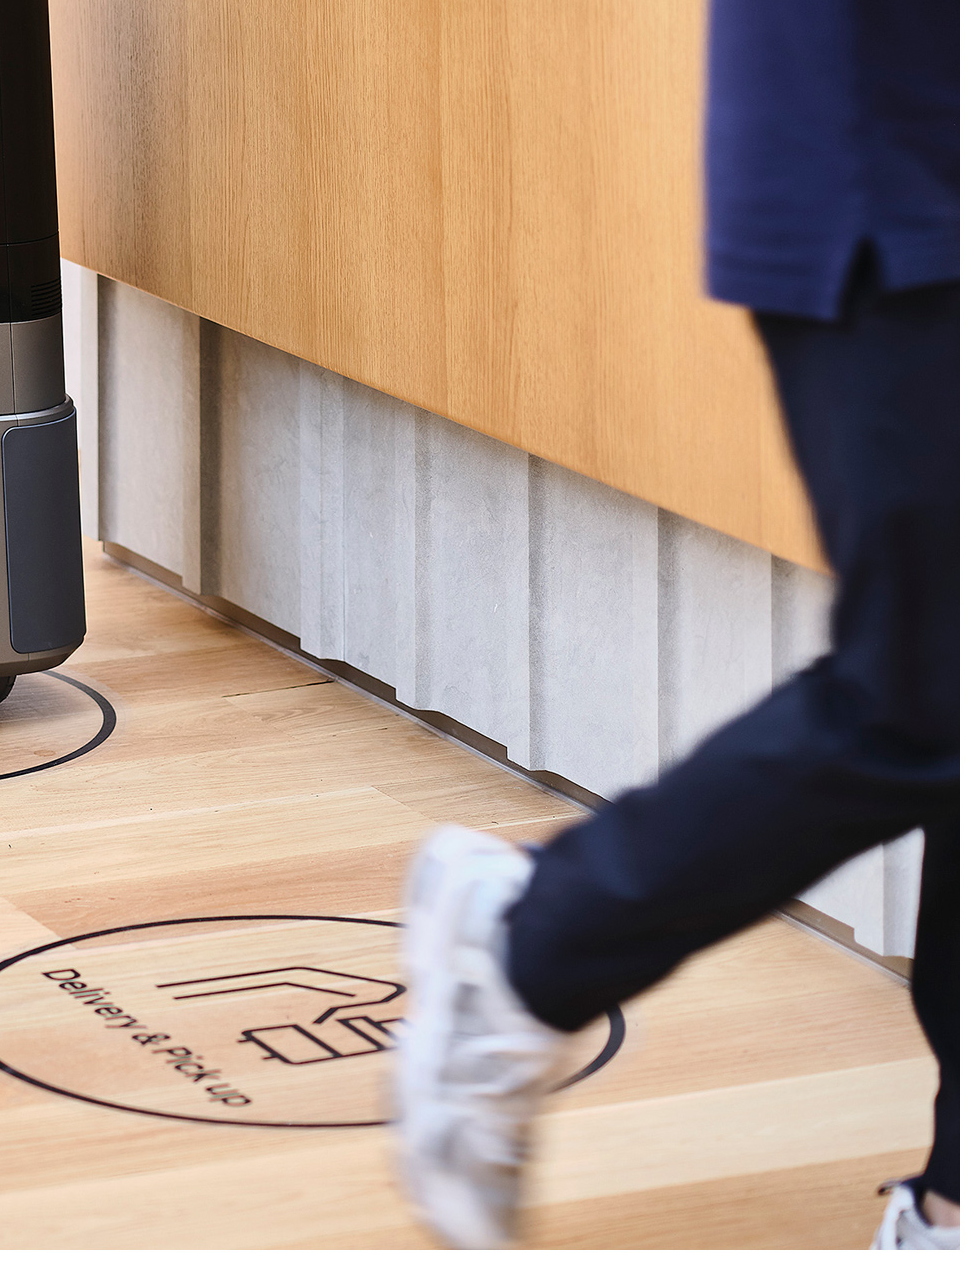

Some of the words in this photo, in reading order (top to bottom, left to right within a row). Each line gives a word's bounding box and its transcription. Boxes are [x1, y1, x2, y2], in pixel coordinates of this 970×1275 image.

[41, 968, 148, 1029] Delivery
[131, 1032, 171, 1046] &
[151, 1047, 222, 1083] Pick
[205, 1083, 252, 1107] up
